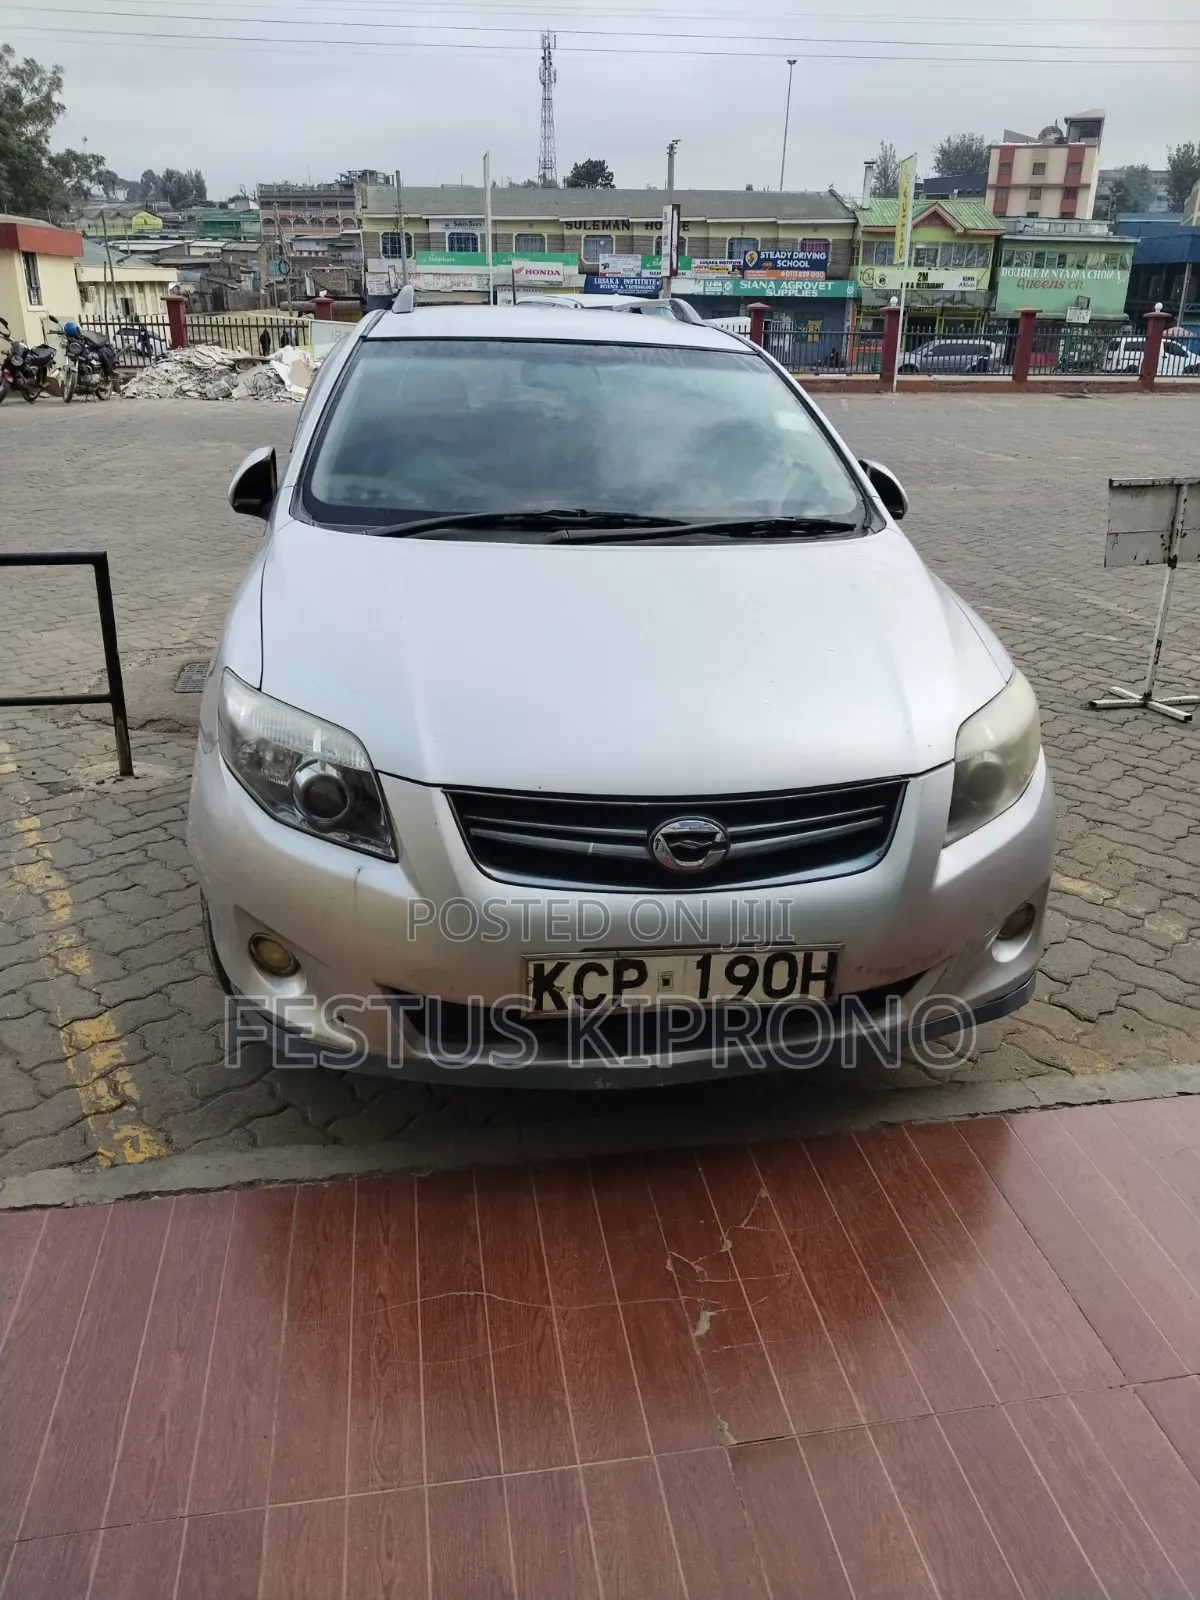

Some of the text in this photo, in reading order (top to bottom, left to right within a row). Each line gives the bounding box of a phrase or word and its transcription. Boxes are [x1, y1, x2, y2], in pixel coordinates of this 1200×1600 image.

[565, 219, 690, 232] SULEMAN HOE
[760, 251, 827, 261] STEADY DRIVING
[776, 260, 810, 268] SCHOOL
[917, 272, 929, 282] 2M
[1001, 268, 1039, 278] DOUBLE
[1051, 269, 1086, 279] NYAMA
[1087, 270, 1121, 280] CHOMA
[739, 281, 835, 291] SIANA AGROVET
[1016, 279, 1066, 291] Queens
[765, 289, 819, 298] SUPPLIES
[532, 950, 836, 1012] KCP 190H
